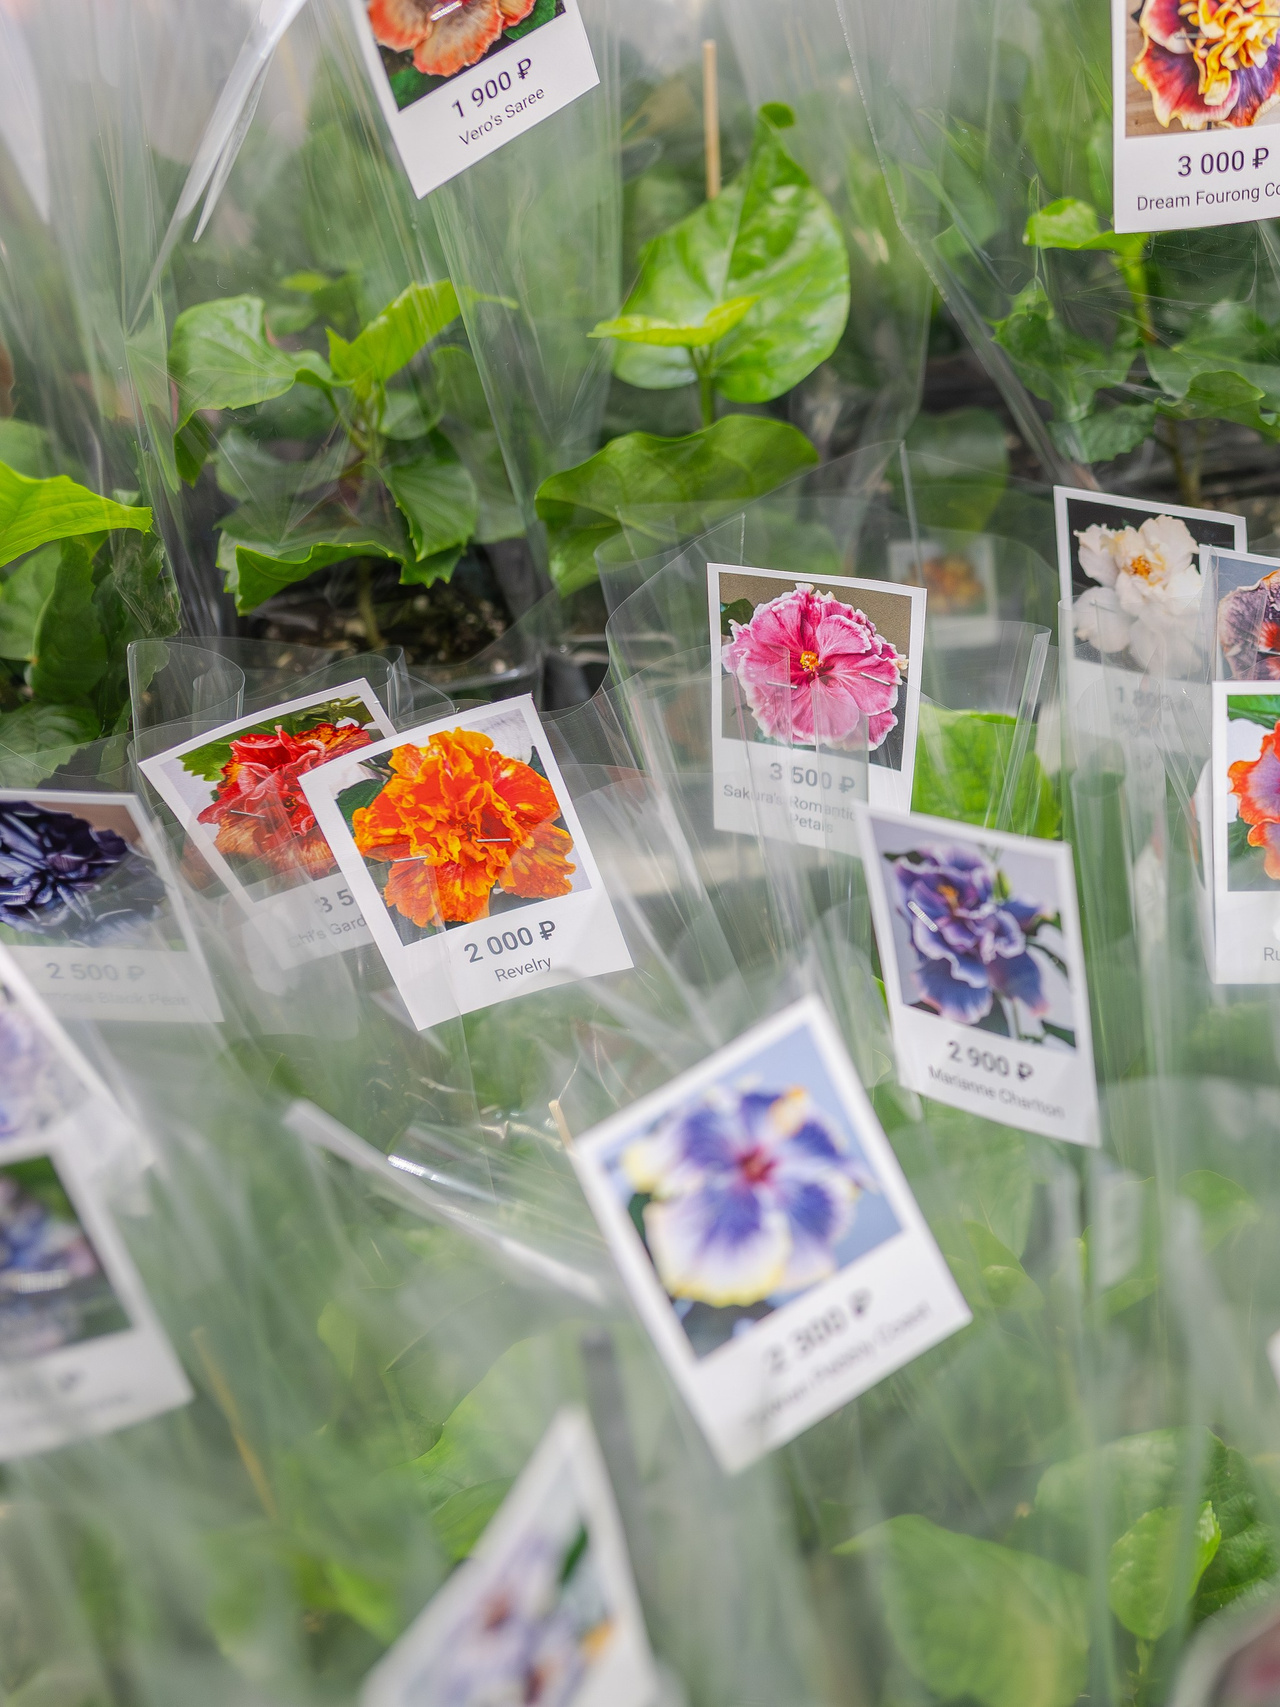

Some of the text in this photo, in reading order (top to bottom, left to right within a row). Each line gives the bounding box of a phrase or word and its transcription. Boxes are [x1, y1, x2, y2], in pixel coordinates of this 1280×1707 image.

[452, 58, 532, 118] 1 900 ₽
[459, 88, 545, 146] Vero's Saree
[1178, 147, 1269, 177] 3 000 ₽
[1137, 195, 1190, 211] Dream
[1196, 187, 1260, 206] Fourong
[769, 762, 856, 794] 3 500 ₽
[314, 896, 333, 913] 3
[330, 914, 367, 935] Gard
[464, 920, 556, 964] 2 000 ₽
[45, 962, 64, 980] 2
[71, 963, 119, 981] 500
[494, 956, 552, 982] Revelry
[946, 1040, 963, 1063] 2
[966, 1045, 1011, 1078] 900
[928, 1064, 997, 1100] Marianne
